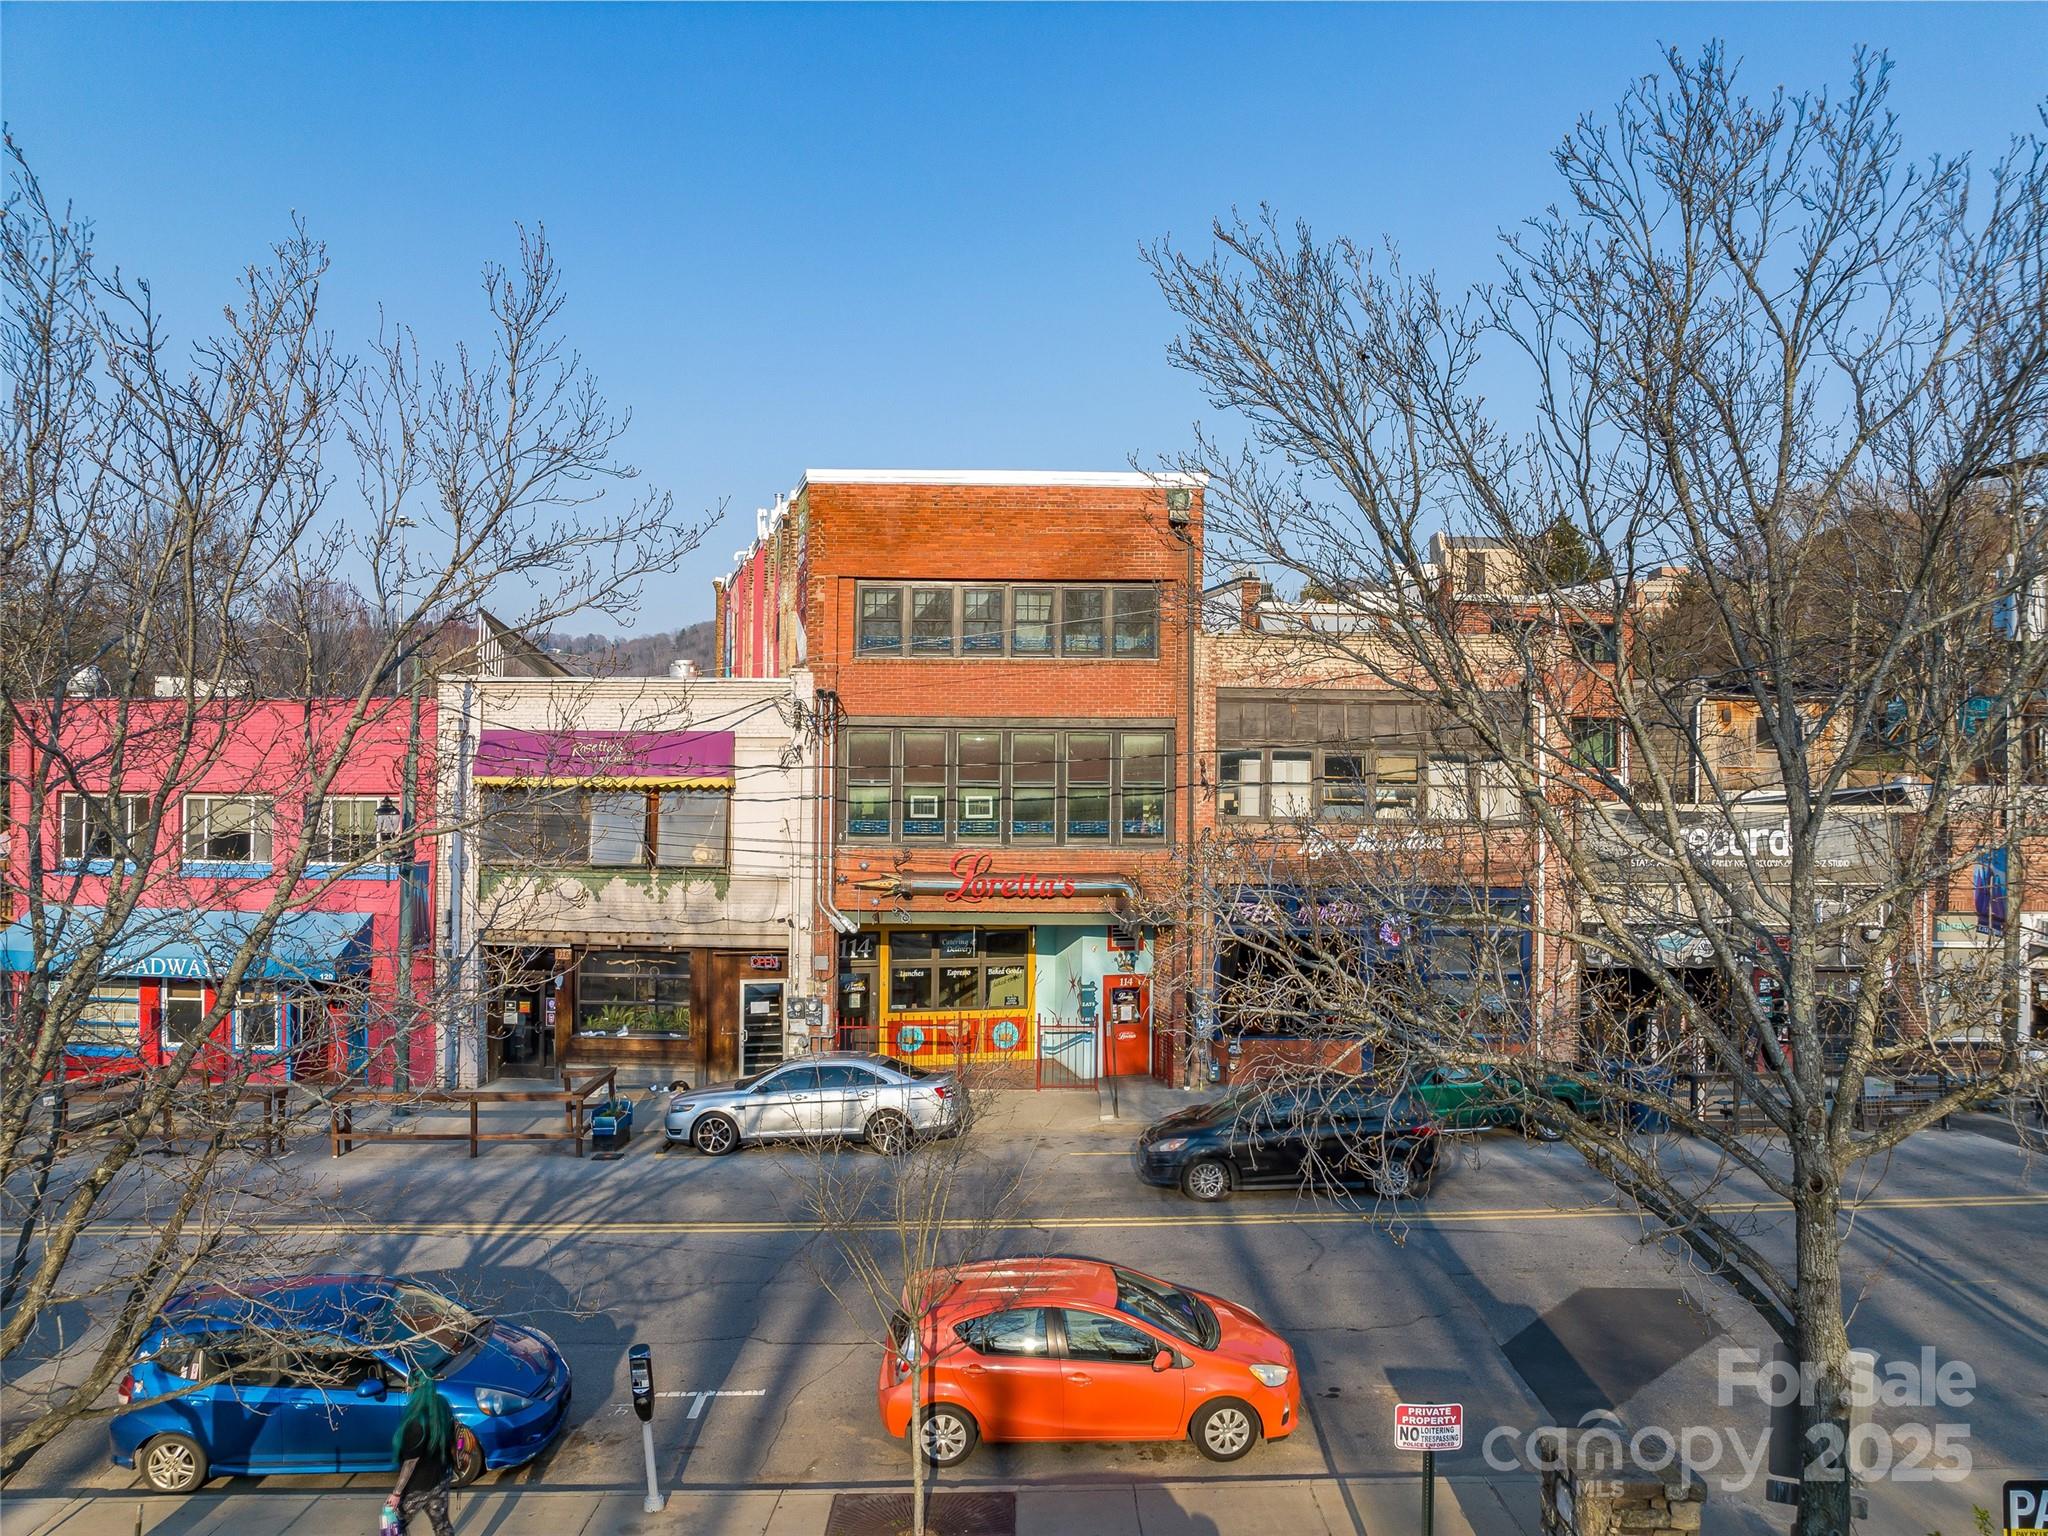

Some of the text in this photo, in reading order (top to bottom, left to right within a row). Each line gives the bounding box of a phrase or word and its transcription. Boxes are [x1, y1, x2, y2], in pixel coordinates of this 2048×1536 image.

[944, 848, 1076, 903] Loretta's
[838, 938, 873, 958] 114
[752, 957, 777, 967] OPEN
[946, 969, 971, 979] Espresso
[987, 968, 1005, 976] Baked
[1120, 977, 1133, 987] 114
[1408, 1407, 1452, 1416] PRIVATE
[1401, 1415, 1457, 1425] PROPERTY
[1400, 1426, 1420, 1442] NO
[1420, 1426, 1455, 1435] LOITERING
[1420, 1434, 1459, 1443] TRESPASSING
